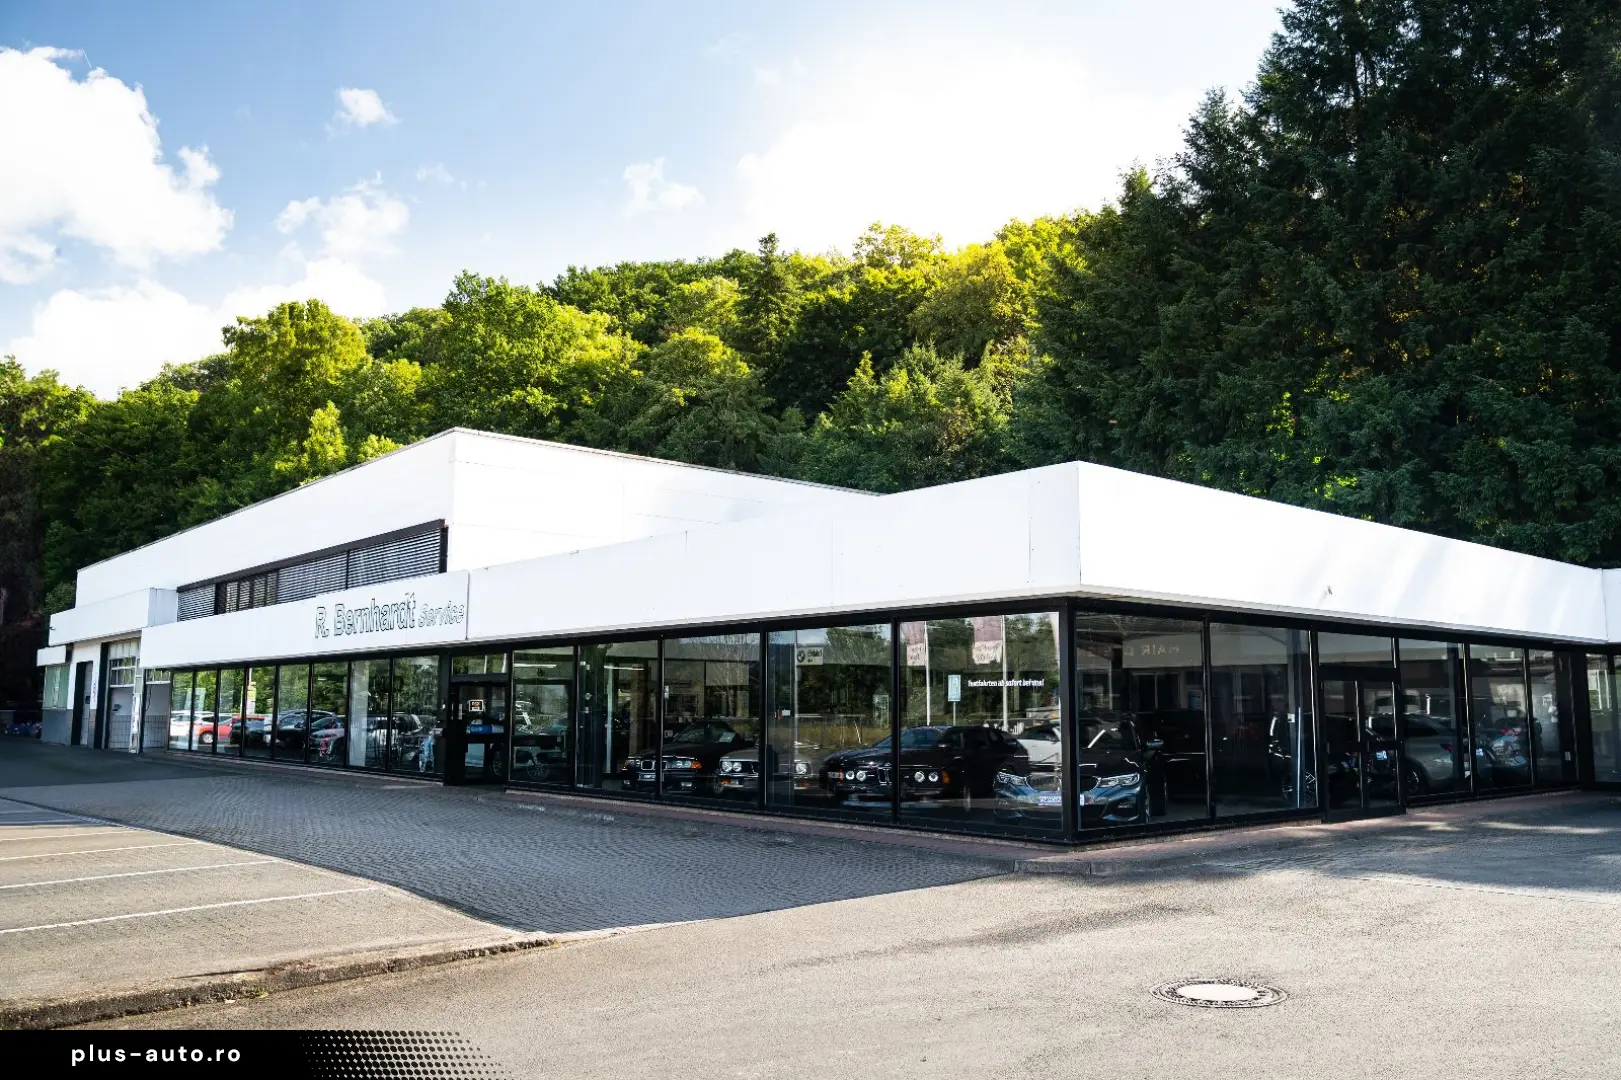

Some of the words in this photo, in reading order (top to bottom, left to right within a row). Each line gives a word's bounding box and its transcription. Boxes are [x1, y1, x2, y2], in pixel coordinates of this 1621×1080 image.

[315, 606, 329, 638] R.
[334, 592, 416, 636] Bernhardt
[418, 600, 465, 628] Service
